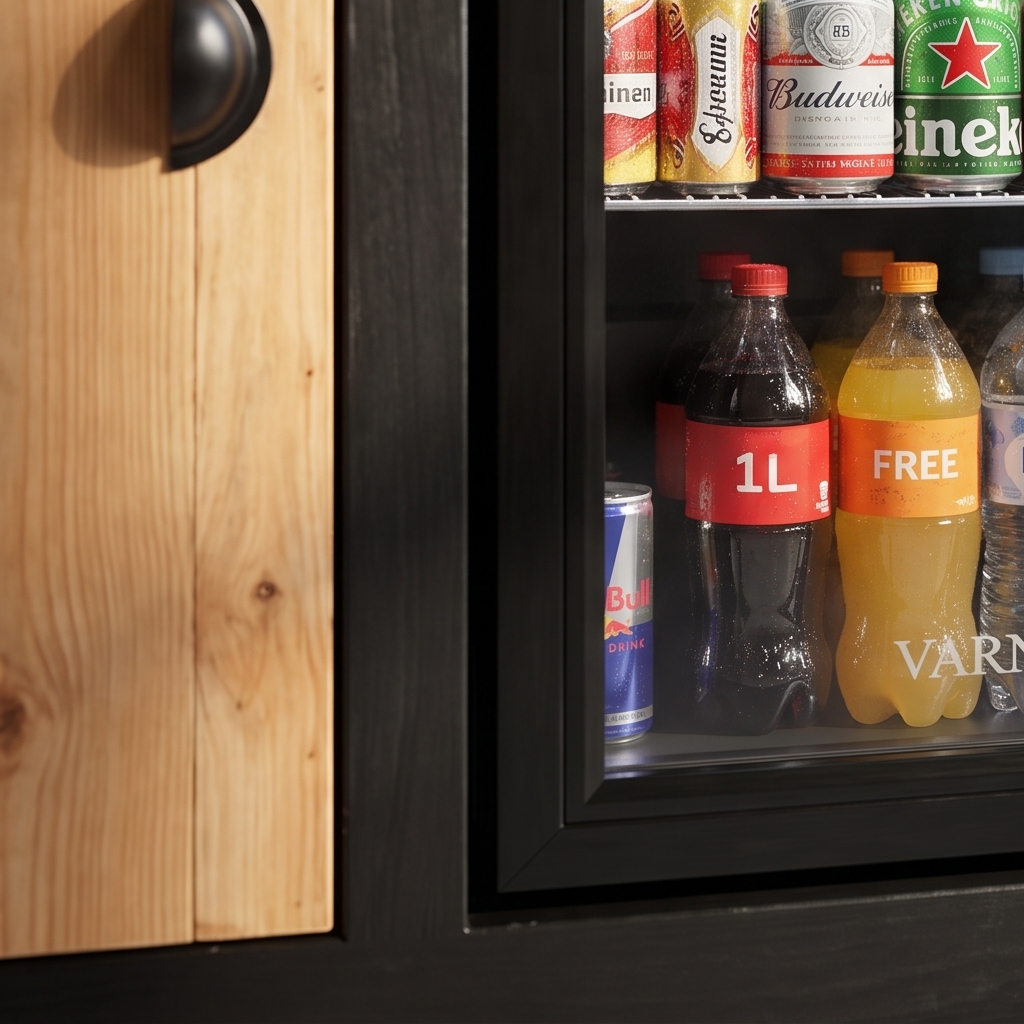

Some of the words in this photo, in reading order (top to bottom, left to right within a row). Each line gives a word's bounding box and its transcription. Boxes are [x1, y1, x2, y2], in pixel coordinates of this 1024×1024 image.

[736, 452, 798, 493] 1L
[873, 448, 959, 480] FREE
[606, 577, 651, 612] Bull
[608, 637, 646, 654] DRINK
